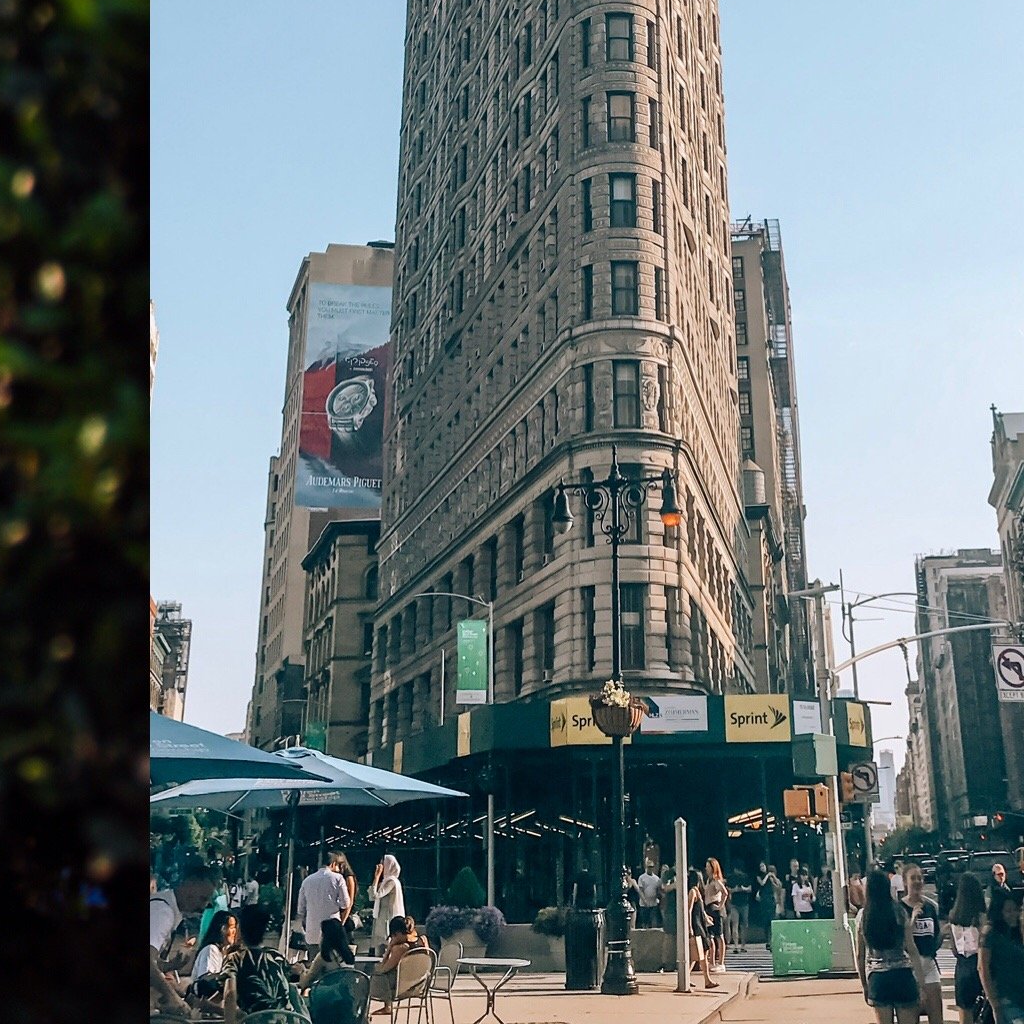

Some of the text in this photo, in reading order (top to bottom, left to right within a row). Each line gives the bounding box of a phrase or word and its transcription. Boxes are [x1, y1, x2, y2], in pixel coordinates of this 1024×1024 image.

[306, 475, 382, 488] AUDEMARS PIGUET
[730, 712, 768, 728] Sprint
